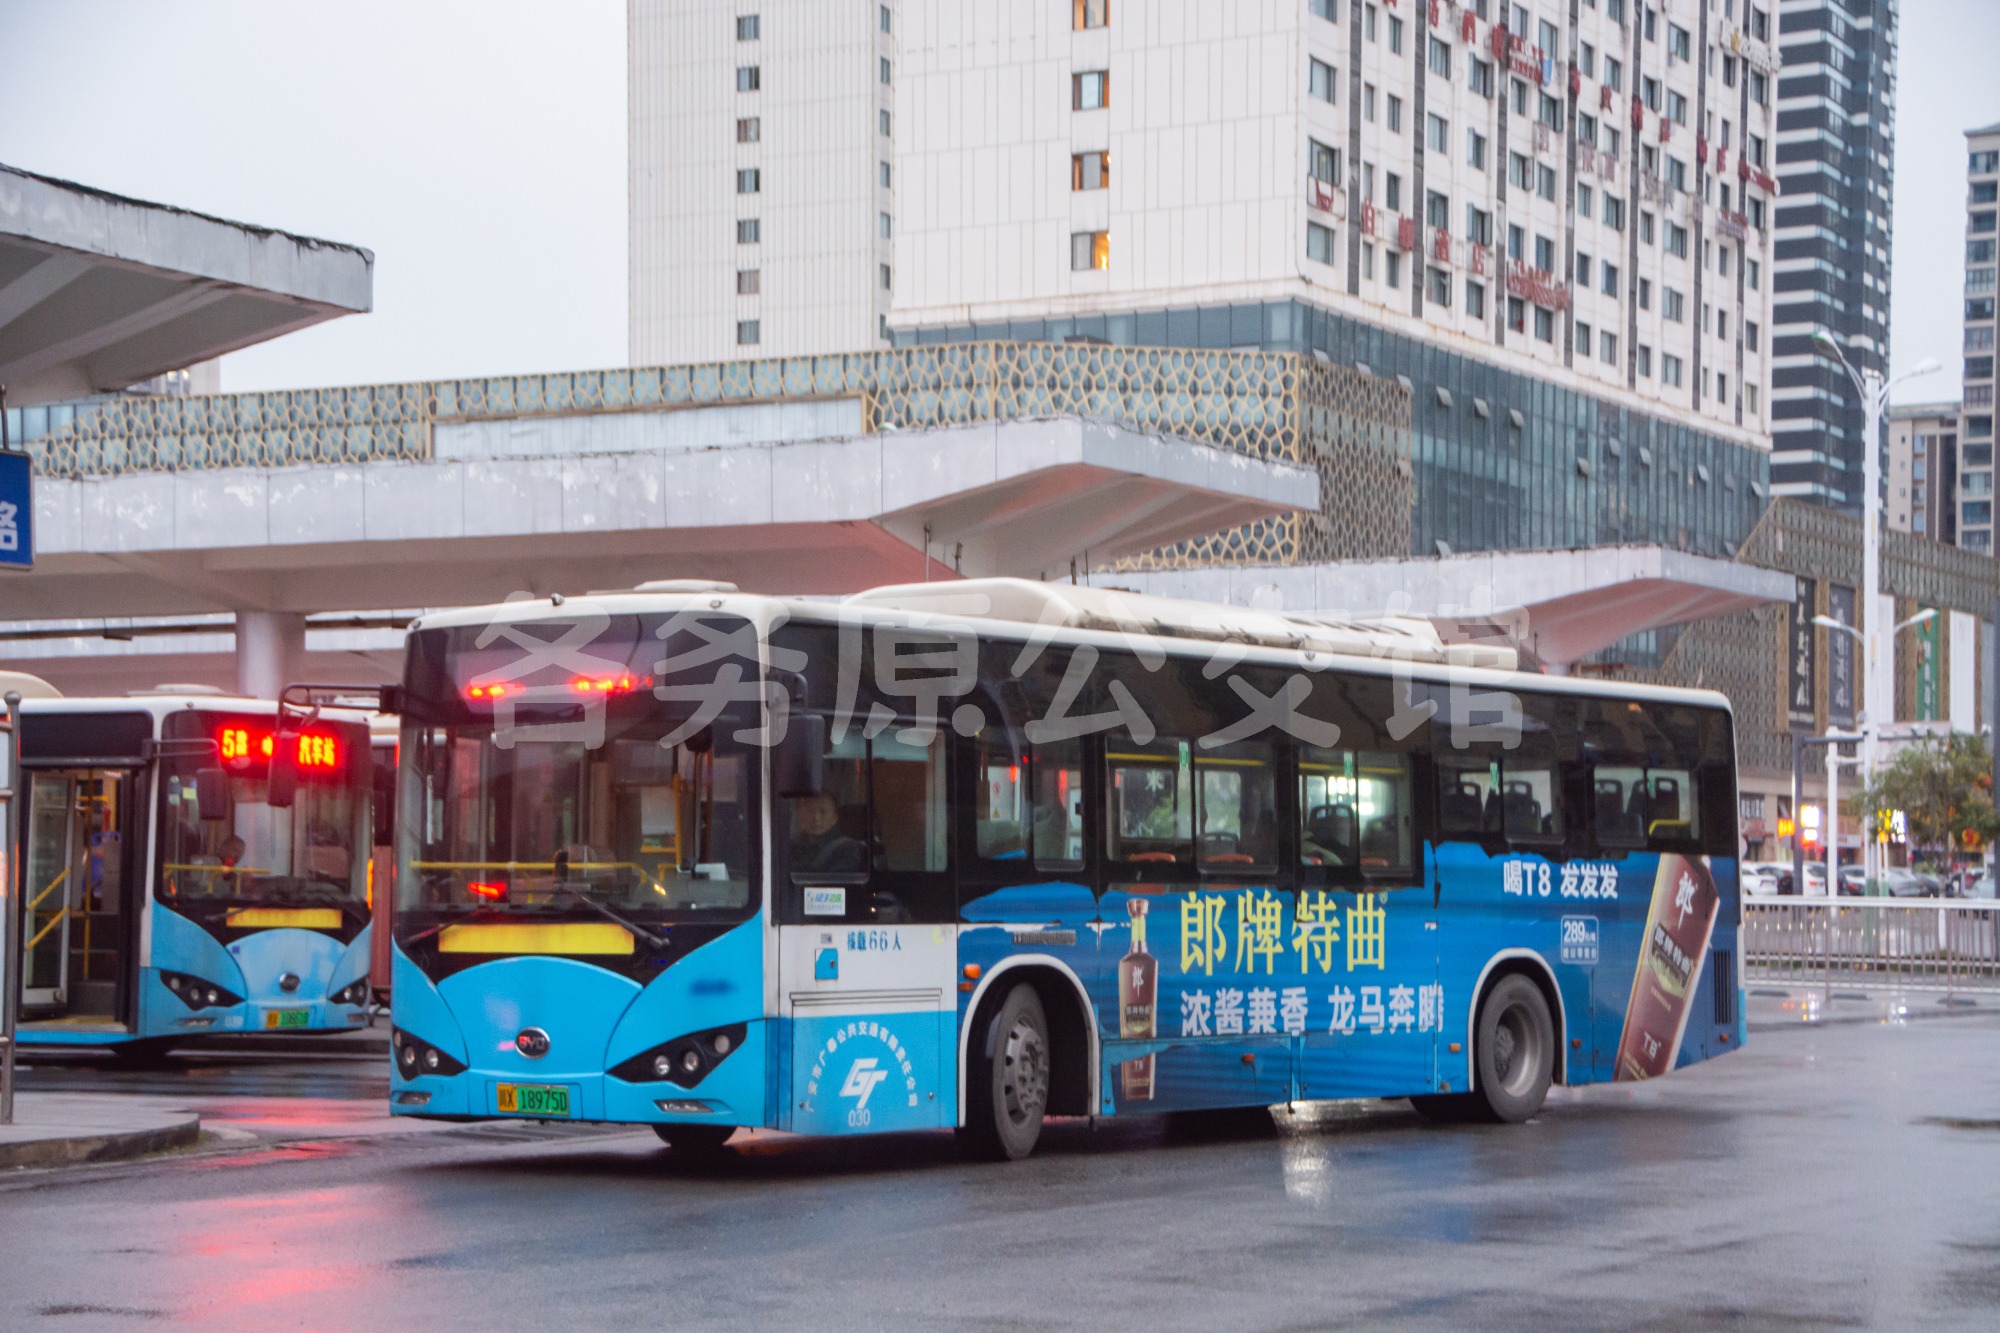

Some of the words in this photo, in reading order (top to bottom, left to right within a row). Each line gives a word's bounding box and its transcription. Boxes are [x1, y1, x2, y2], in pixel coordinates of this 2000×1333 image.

[1560, 863, 1618, 899] 发发发
[1180, 889, 1387, 976] 郎牌特曲
[1180, 986, 1309, 1037] 浓酱兼香
[1328, 984, 1445, 1036] 龙马奔腾
[518, 1035, 546, 1050] BYD
[848, 1109, 871, 1127] 030
